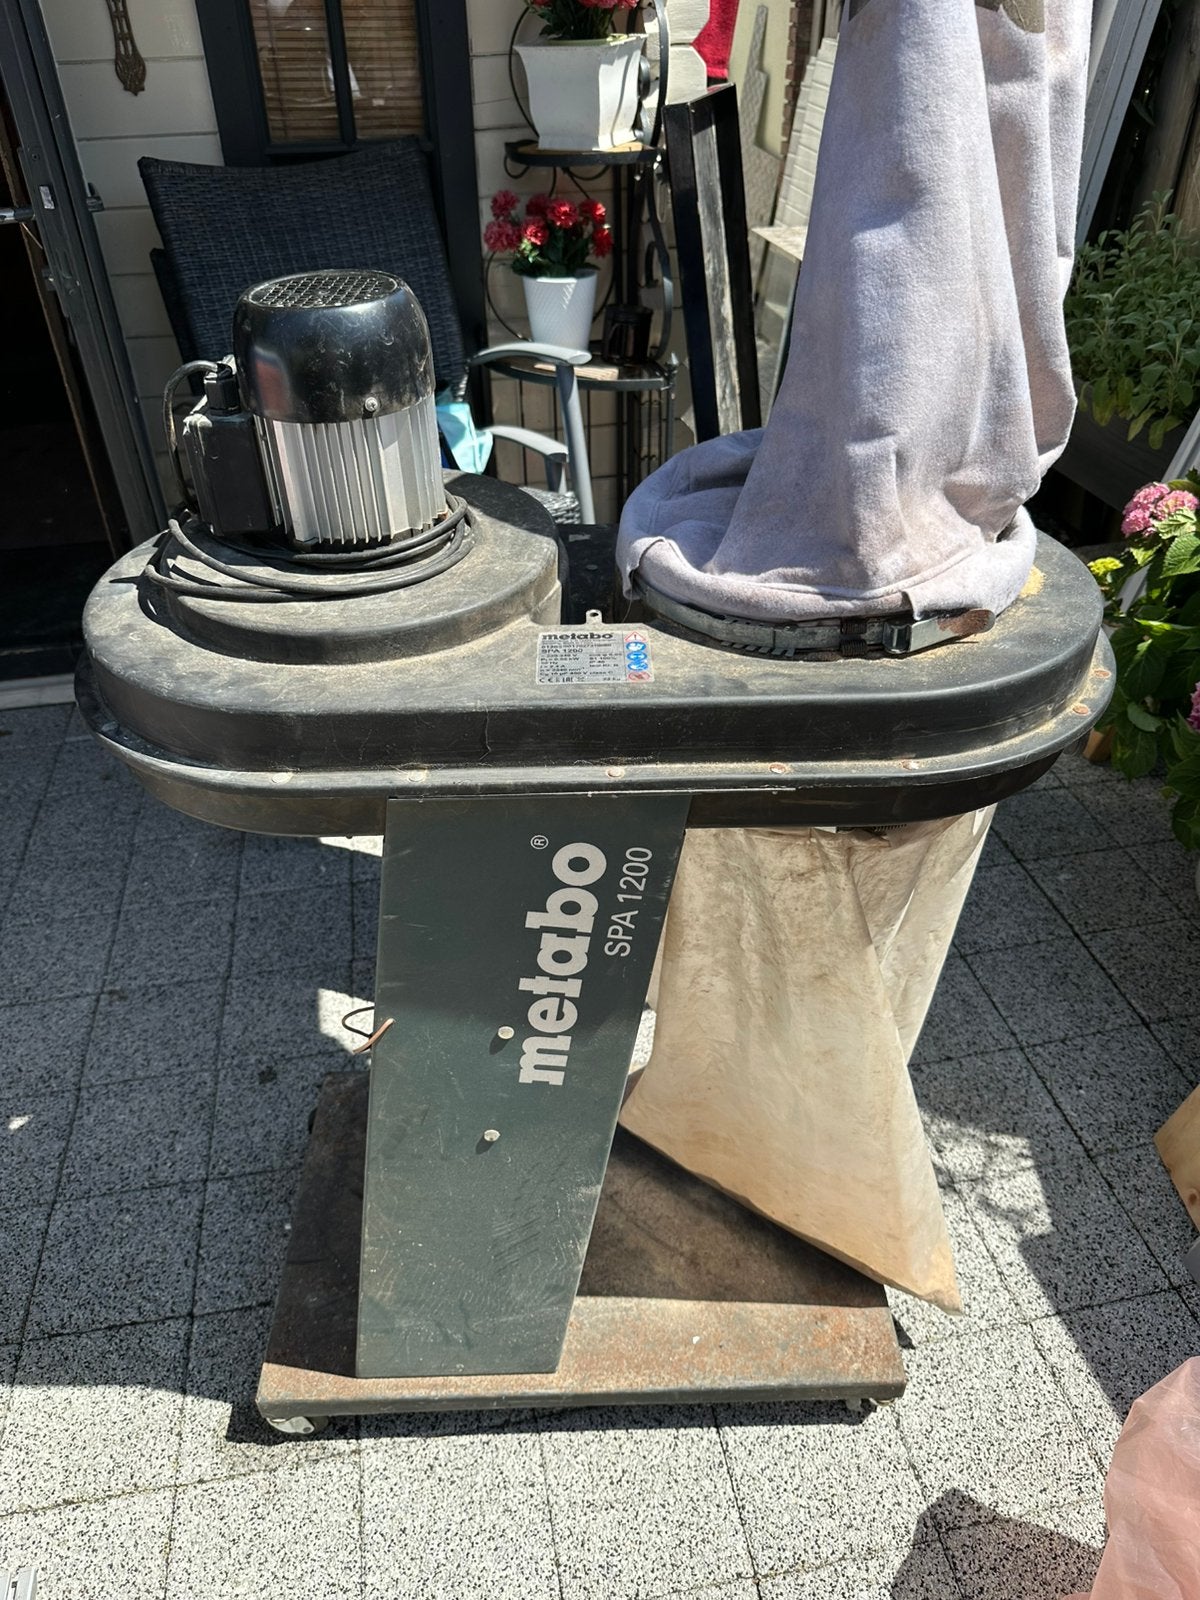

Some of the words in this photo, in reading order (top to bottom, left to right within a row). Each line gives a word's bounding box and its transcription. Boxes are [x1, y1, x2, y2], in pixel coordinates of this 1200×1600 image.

[542, 632, 613, 640] metabo
[617, 846, 653, 900] 1200
[604, 909, 639, 957] SPA
[518, 842, 607, 1086] metabo
